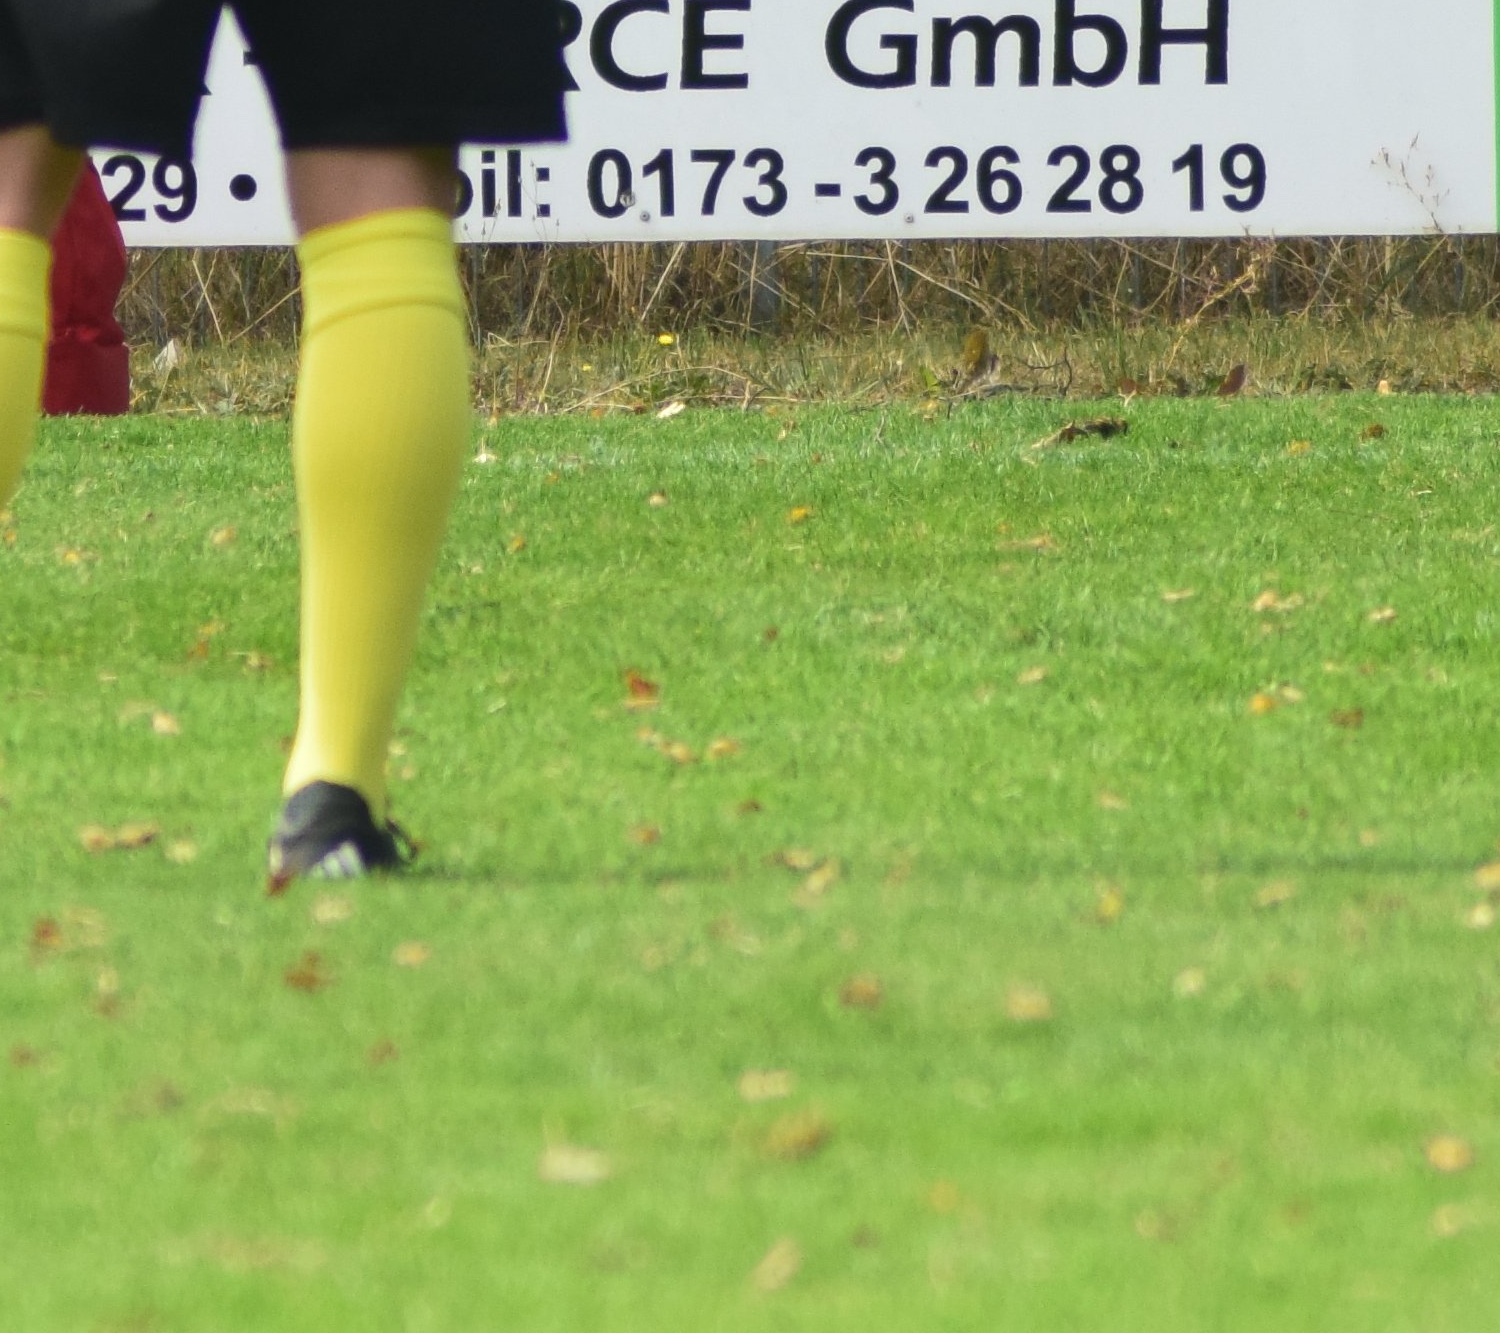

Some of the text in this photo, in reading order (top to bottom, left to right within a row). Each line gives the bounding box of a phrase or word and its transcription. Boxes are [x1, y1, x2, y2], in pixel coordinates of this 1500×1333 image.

[586, 147, 789, 219] 0173
[923, 144, 1023, 215] 26
[1045, 143, 1145, 215] 28
[1171, 142, 1268, 213] 19
